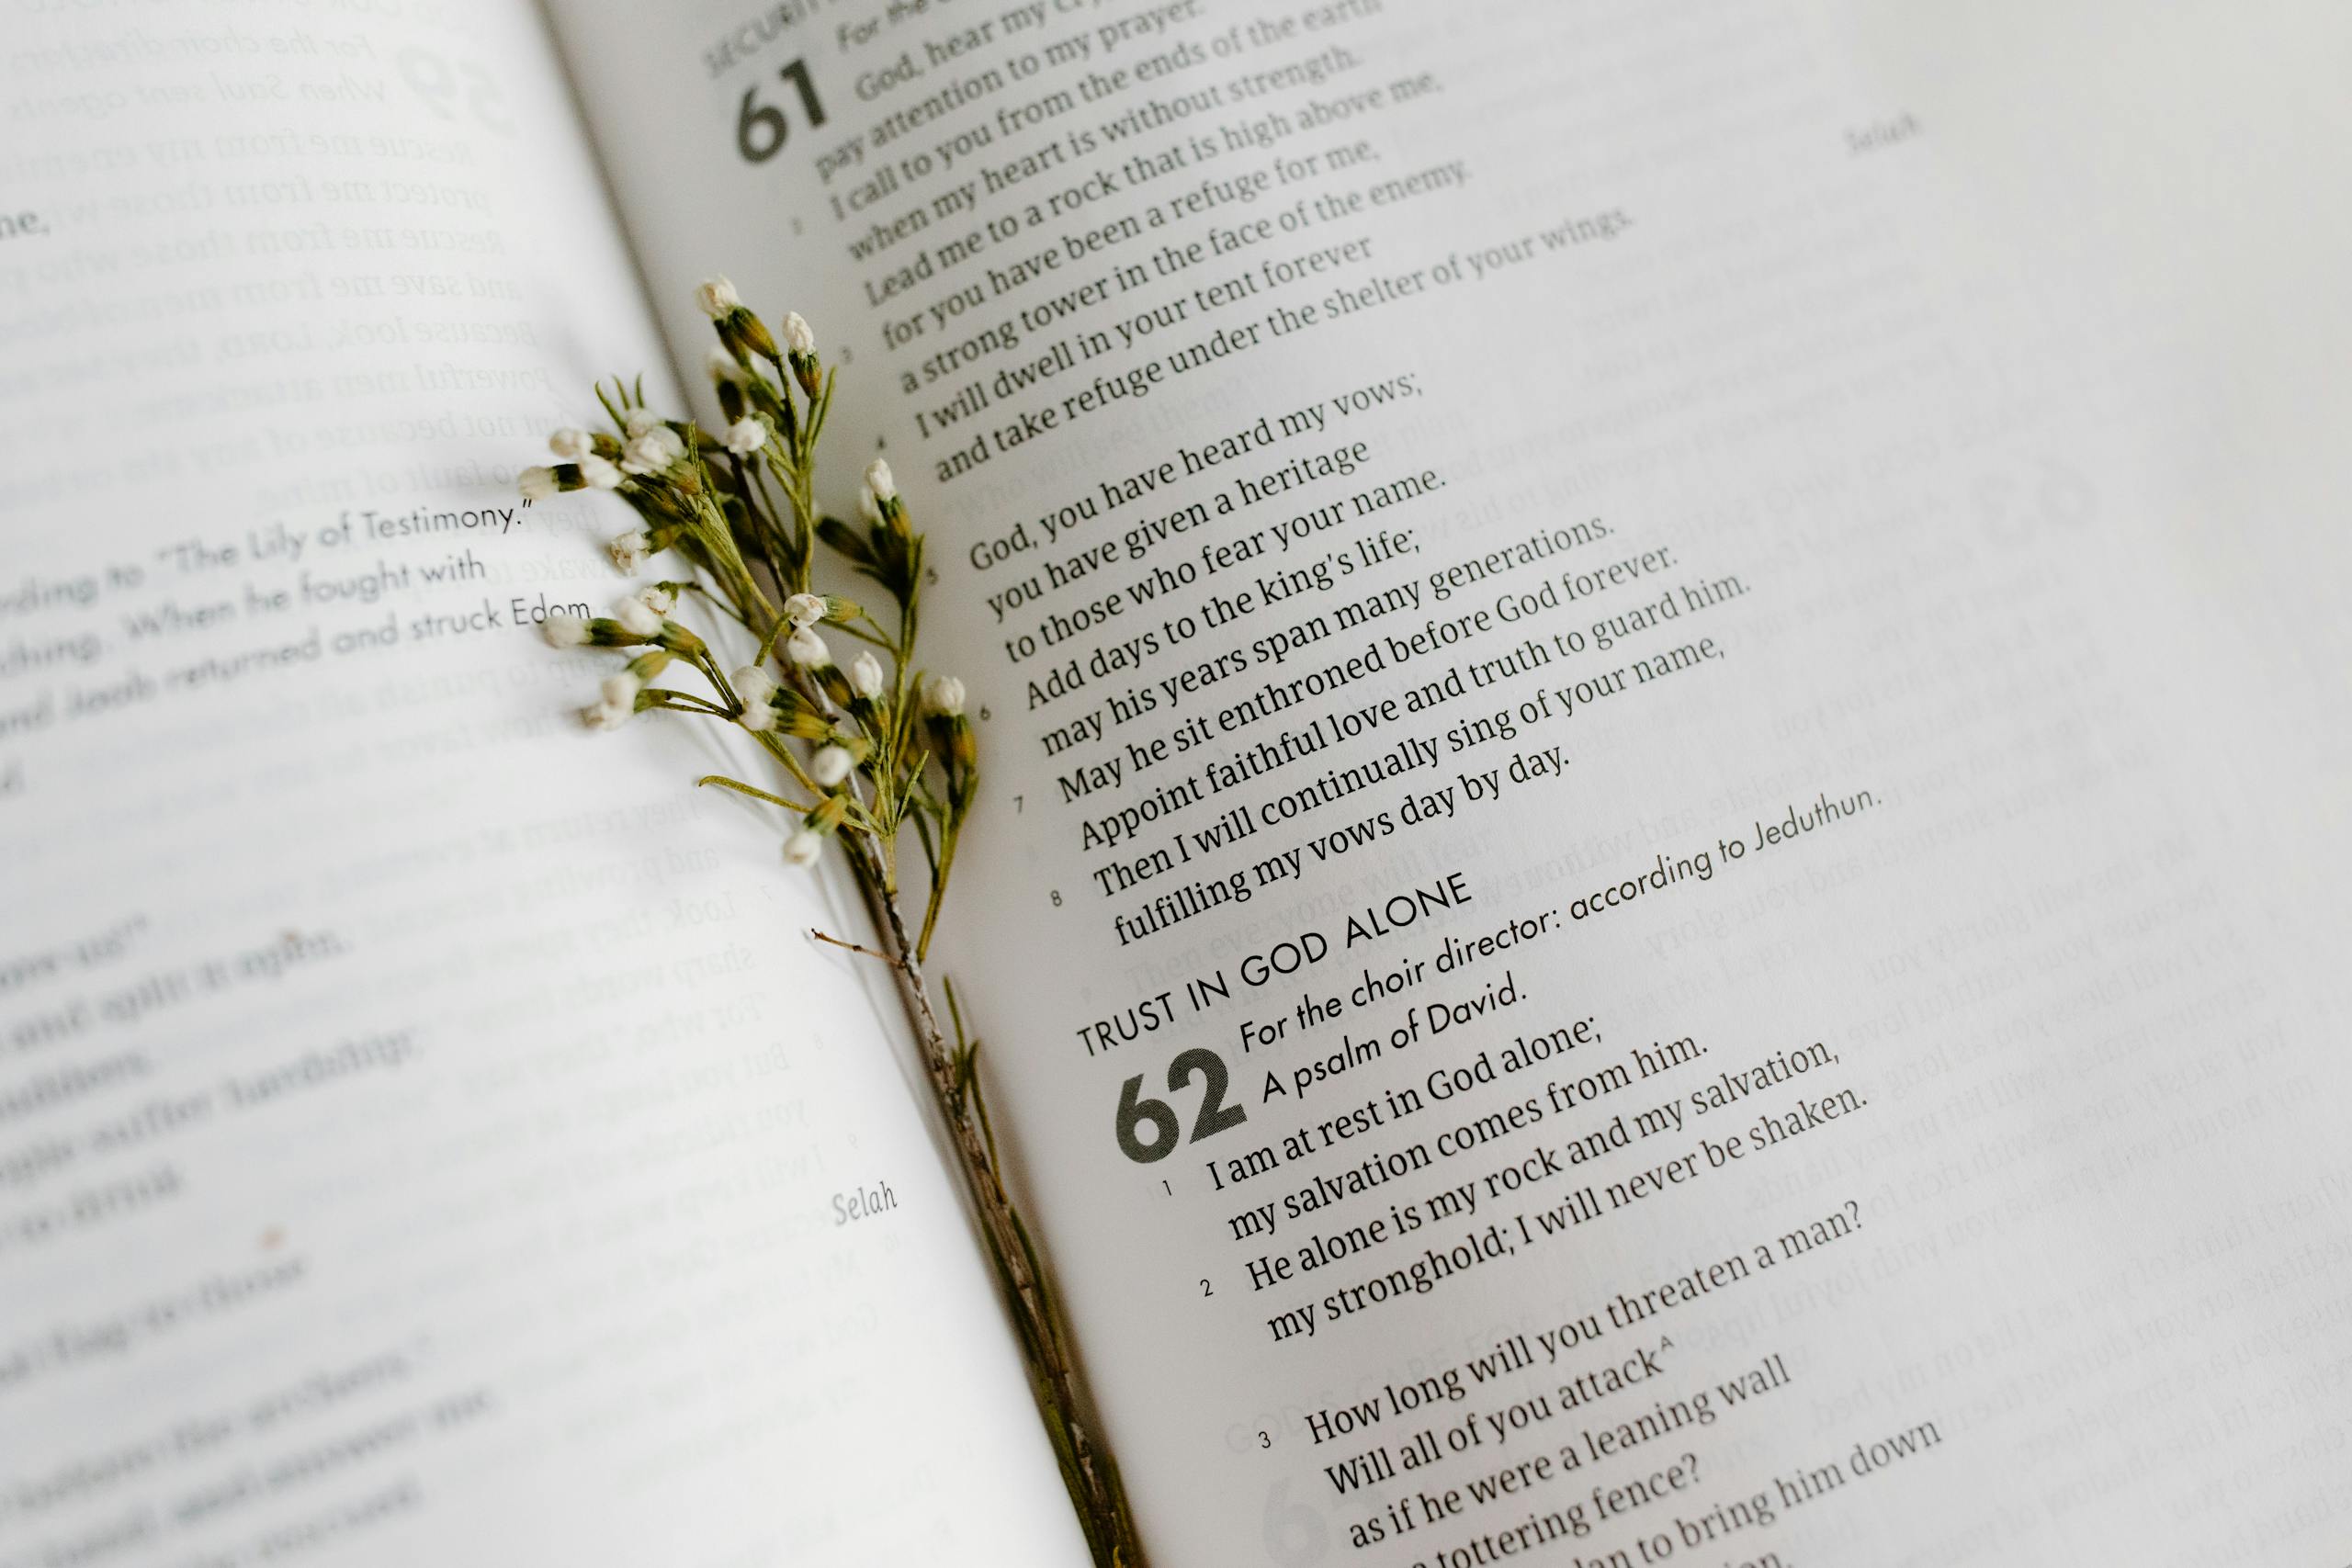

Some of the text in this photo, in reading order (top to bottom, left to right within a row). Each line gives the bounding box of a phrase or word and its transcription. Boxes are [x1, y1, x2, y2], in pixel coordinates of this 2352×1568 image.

[736, 57, 827, 166] 61
[935, 209, 1633, 482] and take refuge under the shelter of your wings.
[318, 510, 353, 547] of
[969, 523, 1037, 570] God,
[1038, 497, 1098, 544] you
[1099, 462, 1176, 509] have
[1177, 416, 1274, 475] heard
[1278, 403, 1324, 436] my
[1332, 373, 1421, 415] vows;
[987, 442, 1366, 623] you have given a heritage
[1004, 470, 1445, 662] to those who fear your name.
[298, 548, 486, 605] fought with
[411, 596, 503, 640] struck
[978, 529, 1419, 721] 6 Add days to the king's life;
[1041, 517, 1613, 757] may his years span many generations.
[1013, 547, 1677, 814] 7 May he sit enthroned before God forever.
[1049, 638, 1724, 908] 8 Then I will continually sing of your name,
[1082, 576, 1749, 851] Appoint faithful love and truth to guard him.
[1114, 746, 1569, 946] fulfilling my vows day by day.
[1239, 790, 1881, 1053] For the choir director: according to Jeduthun.
[1076, 872, 1472, 1055] TRUST IN GOD ALONE
[1262, 970, 1526, 1103] A psalm of David.
[1115, 1047, 1249, 1164] 62
[1161, 1016, 1601, 1197] 1 I am at rest in God alone;
[1199, 1042, 1838, 1298] 2 He alone is my rock and my salvation,
[1227, 1036, 1707, 1240] my salvation comes from him.
[831, 1179, 899, 1227] Selah
[1266, 1089, 1867, 1341] my stronghold; I will never be shaken.
[1258, 1200, 1861, 1449] 3 How long will you threaten a man?
[1323, 1446, 1396, 1495] Will
[1399, 1429, 1442, 1470] all
[1447, 1413, 1481, 1451] of
[1486, 1395, 1552, 1444] you
[1349, 1353, 1791, 1548] as if he were a leaning wall
[1435, 1452, 1698, 1568] tottering fence?
[1636, 1421, 1941, 1564] to bring him down
